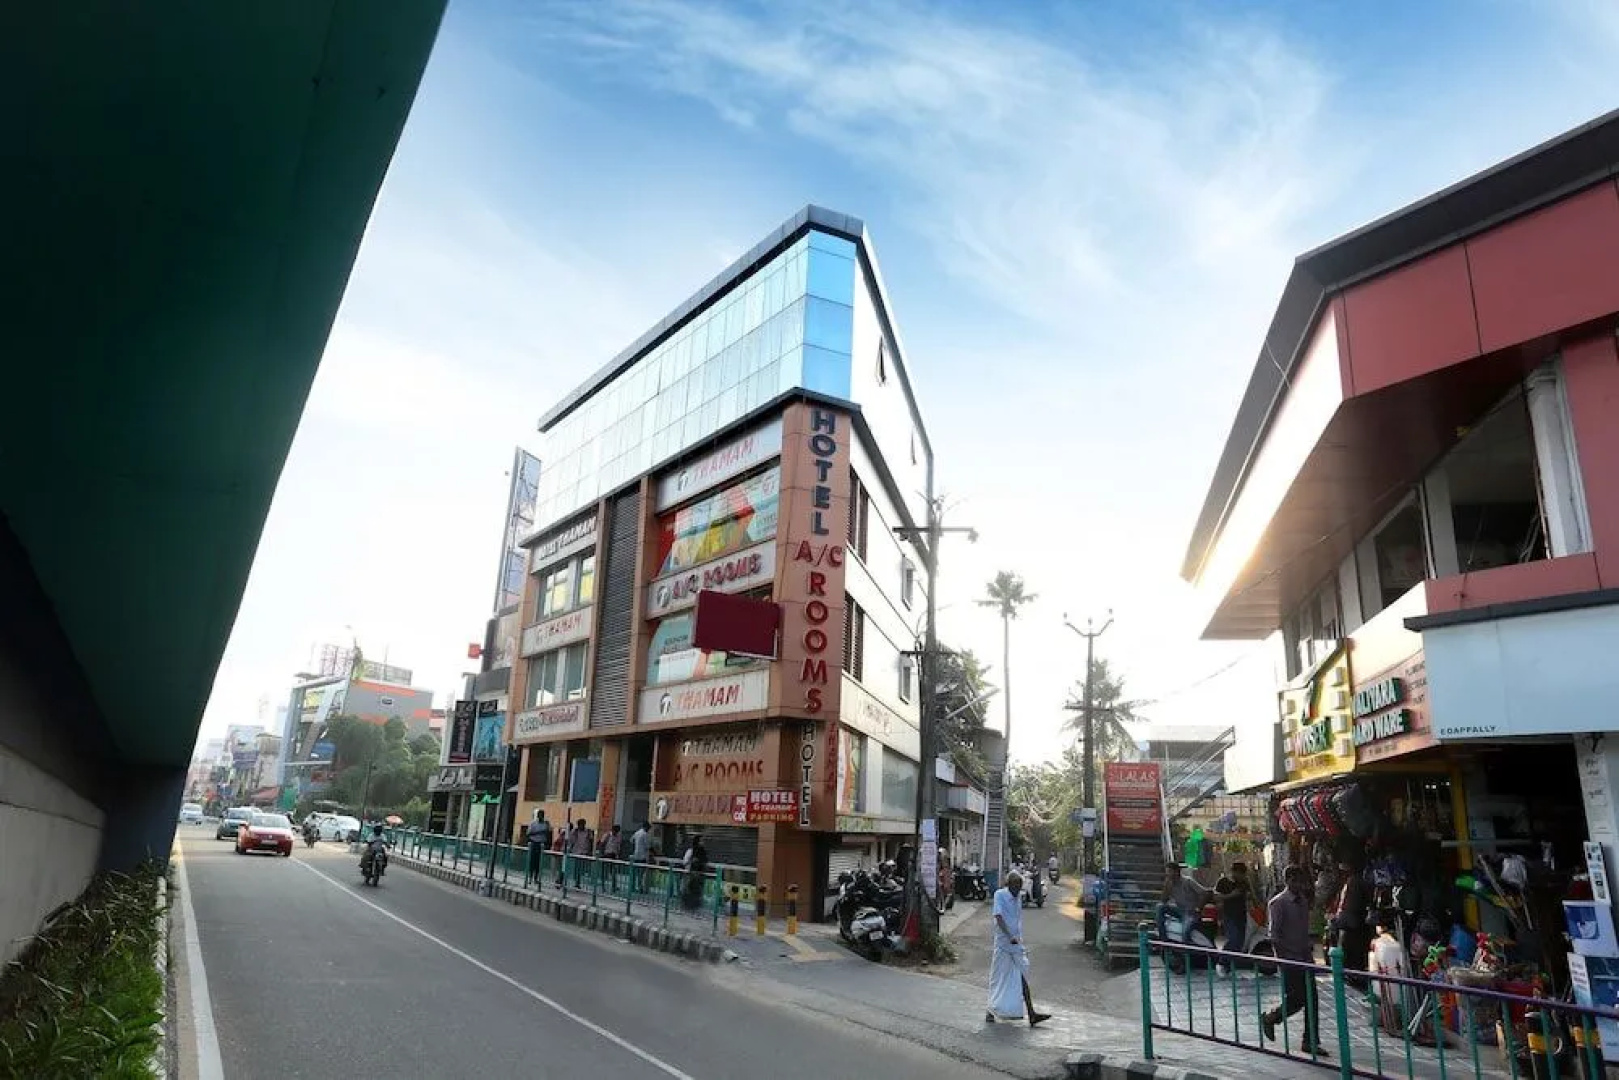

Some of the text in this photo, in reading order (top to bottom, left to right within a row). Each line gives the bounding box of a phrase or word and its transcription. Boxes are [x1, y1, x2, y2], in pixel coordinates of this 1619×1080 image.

[809, 407, 836, 536] HOTEL
[794, 540, 843, 568] A/C
[703, 553, 761, 588] ROOMS
[801, 571, 829, 714] ROOMS
[677, 684, 740, 709] THAMAM
[705, 760, 764, 783] ROOMS
[800, 722, 816, 827] HOTEL
[750, 791, 796, 803] HOTEL
